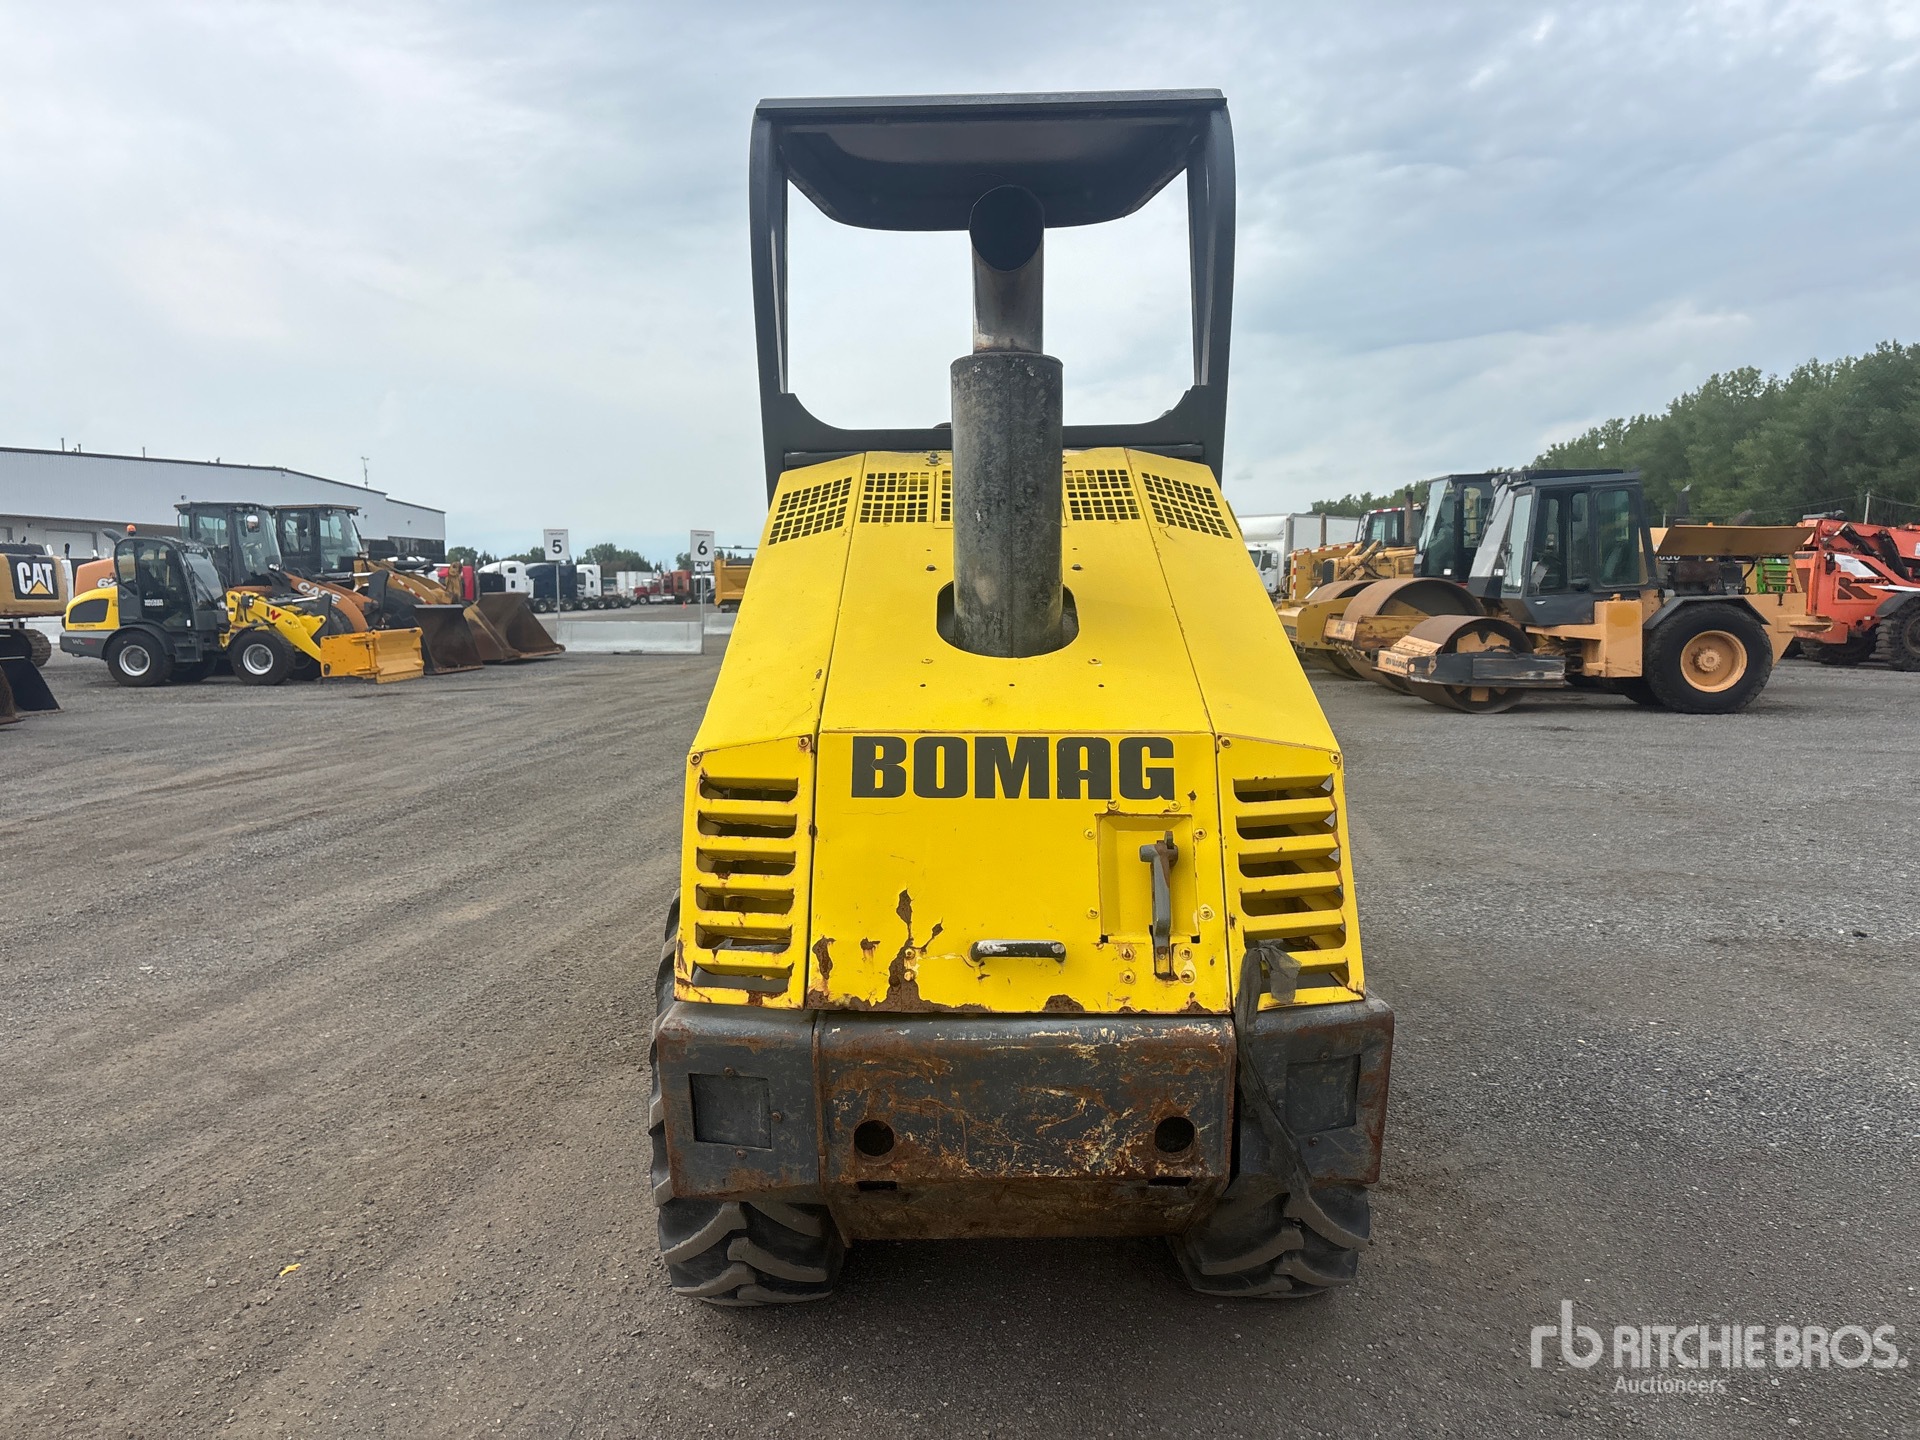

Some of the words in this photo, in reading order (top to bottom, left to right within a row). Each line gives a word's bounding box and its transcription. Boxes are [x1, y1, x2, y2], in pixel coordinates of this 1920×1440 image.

[552, 539, 563, 555] 5
[697, 540, 708, 556] 6
[16, 562, 54, 596] CAT
[851, 736, 1176, 801] BOMAG
